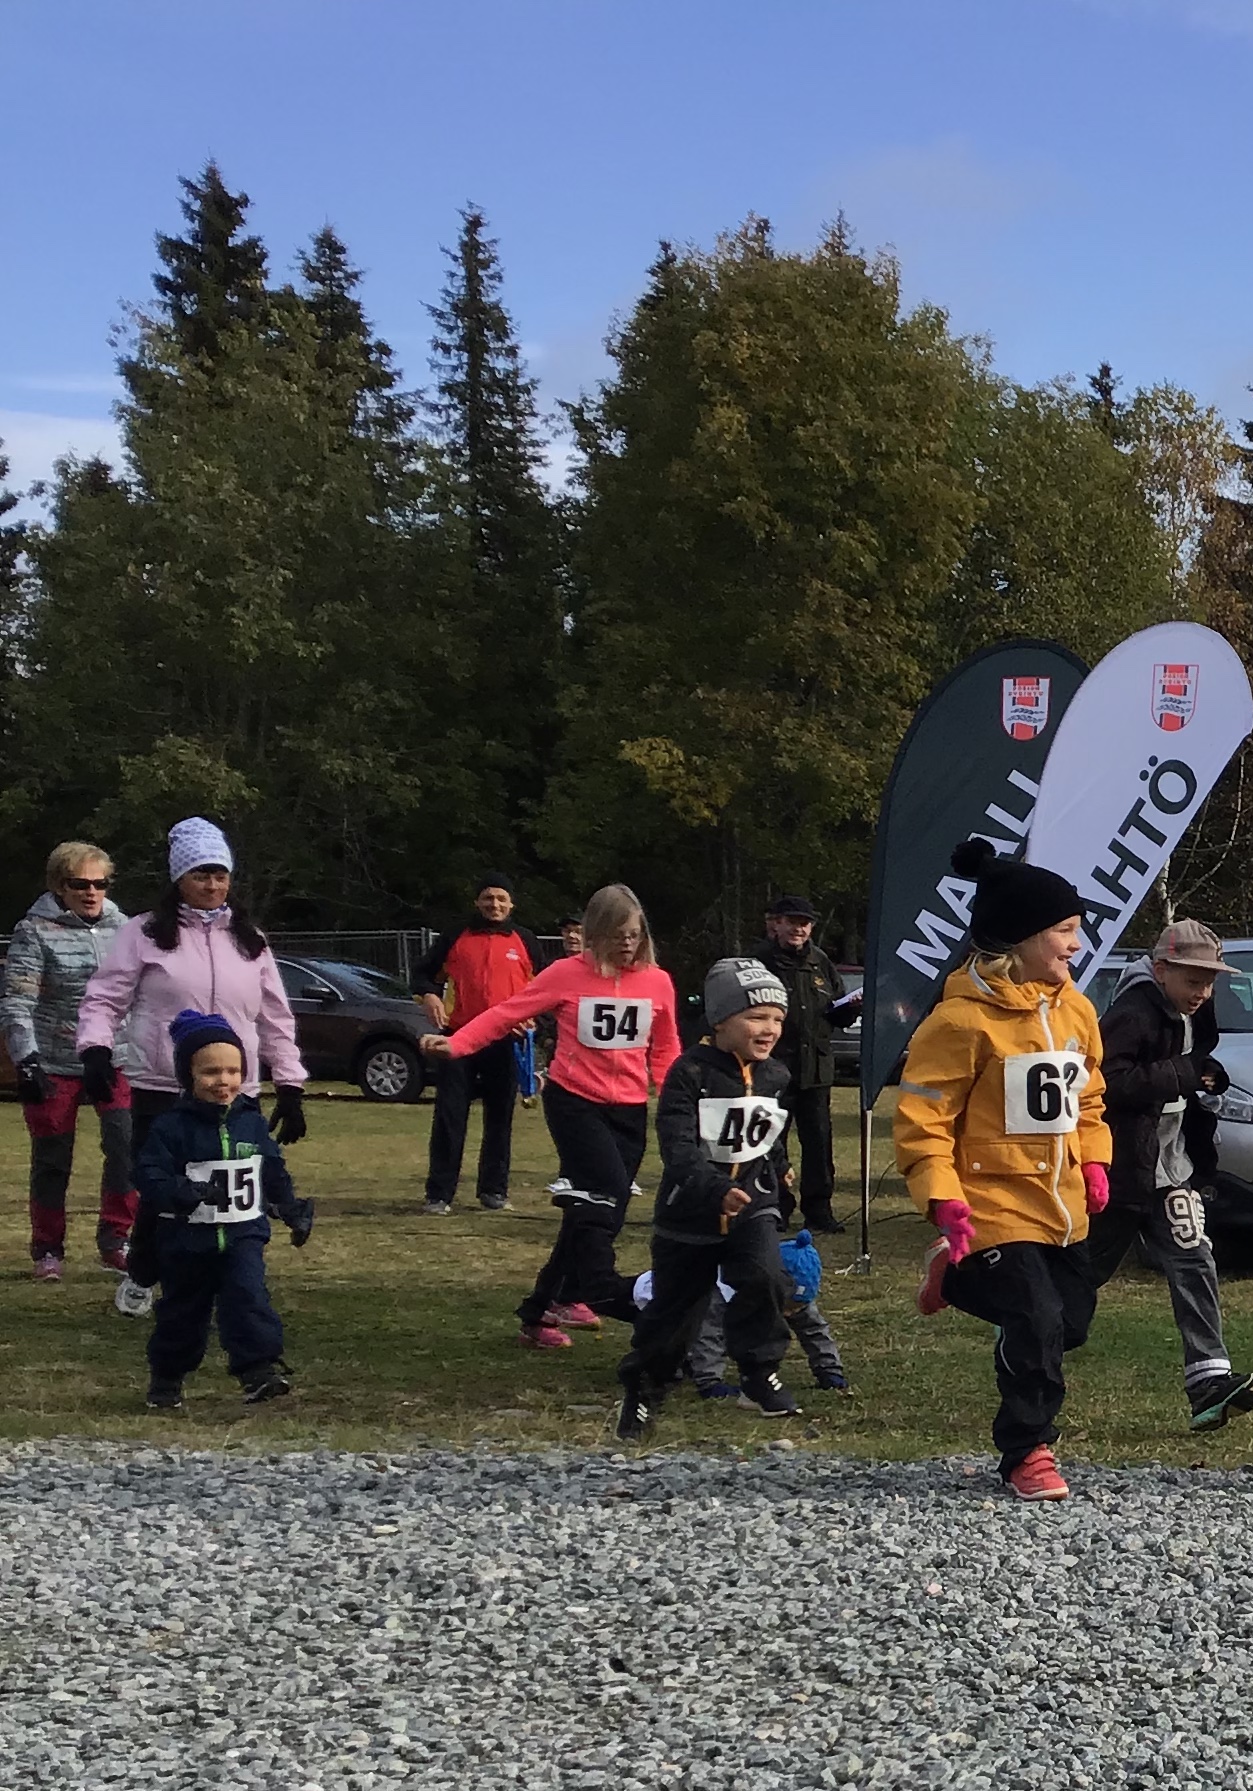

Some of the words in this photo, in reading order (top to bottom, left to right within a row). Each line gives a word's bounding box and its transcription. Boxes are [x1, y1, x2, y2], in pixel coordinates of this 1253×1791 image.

[747, 987, 788, 1006] NOISE
[592, 1004, 639, 1042] 54
[717, 1105, 772, 1153] 46
[204, 1167, 254, 1213] 45
